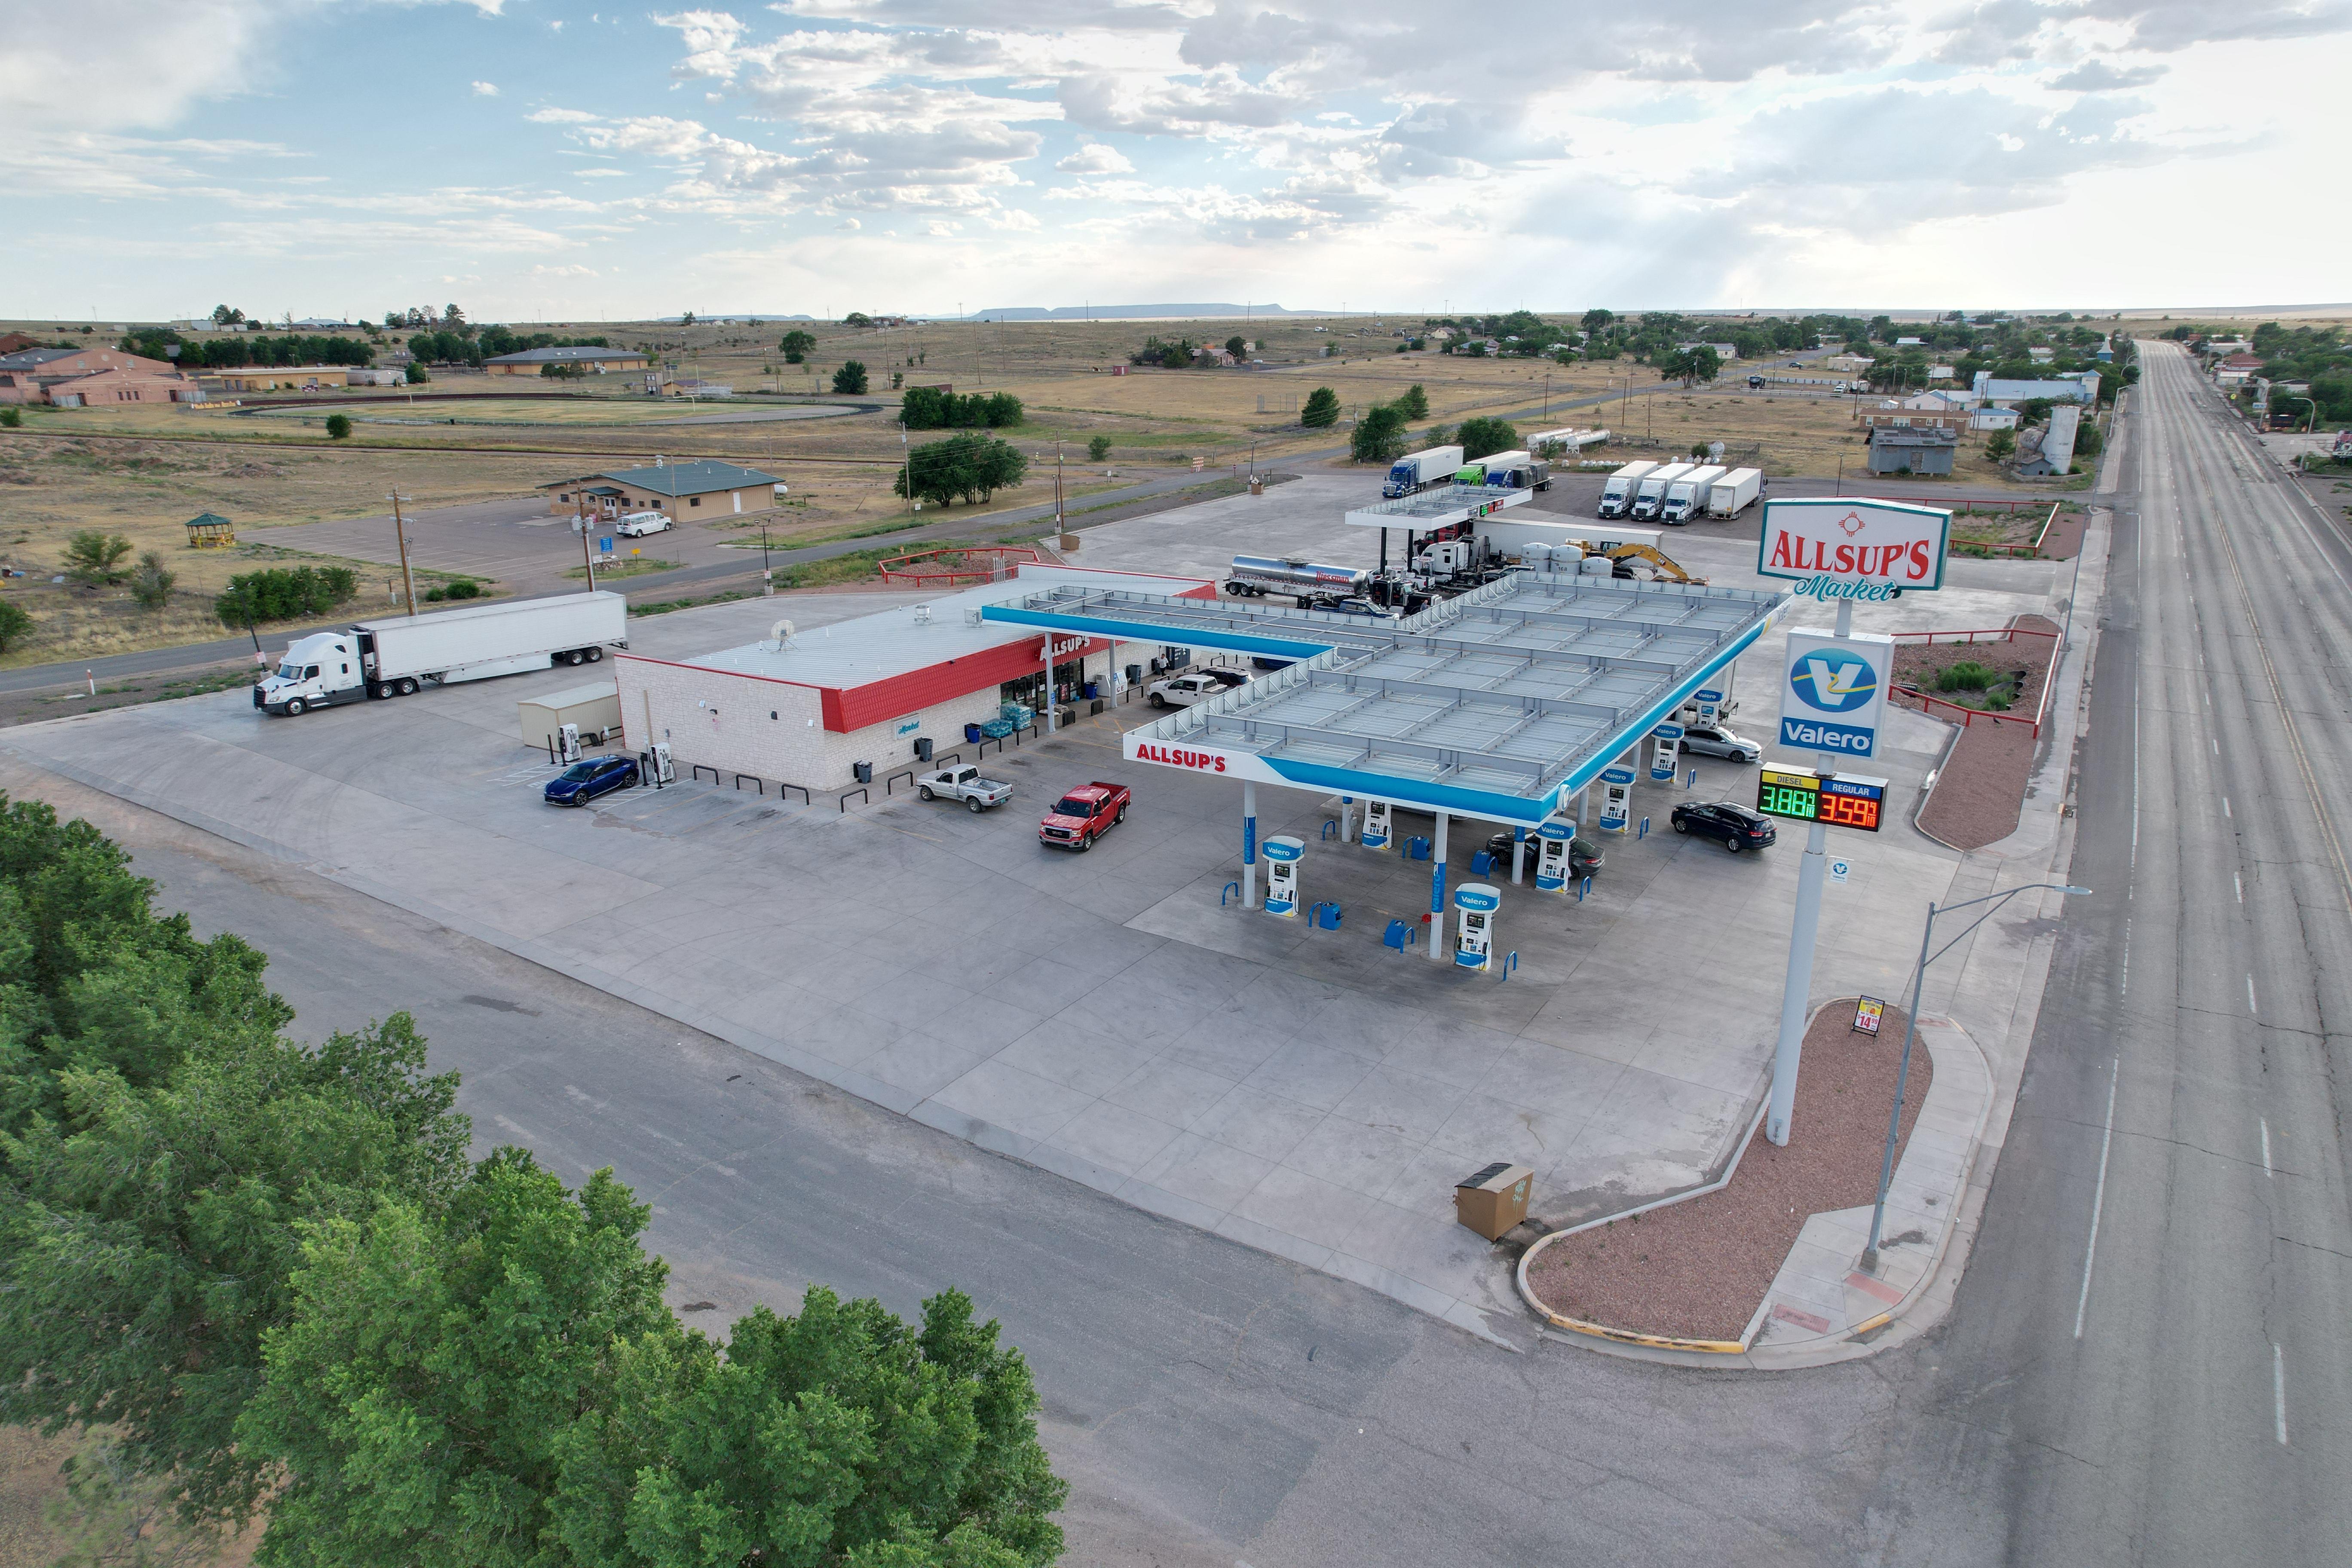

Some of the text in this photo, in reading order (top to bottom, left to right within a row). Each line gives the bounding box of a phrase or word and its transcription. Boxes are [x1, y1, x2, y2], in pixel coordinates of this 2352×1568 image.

[1769, 529, 1929, 580] ALLSUP'S
[1316, 570, 1349, 583] Viessman
[1794, 574, 1896, 602] Market
[1039, 636, 1090, 661] ALSUP'S
[1785, 722, 1870, 750] Valero
[1136, 744, 1225, 772] ALLSUP'S
[1777, 776, 1803, 786] DIESEL
[1832, 784, 1869, 796] REGULAR
[1541, 826, 1565, 835] Valero
[1268, 847, 1290, 856] Valero
[1461, 896, 1488, 906] Valero
